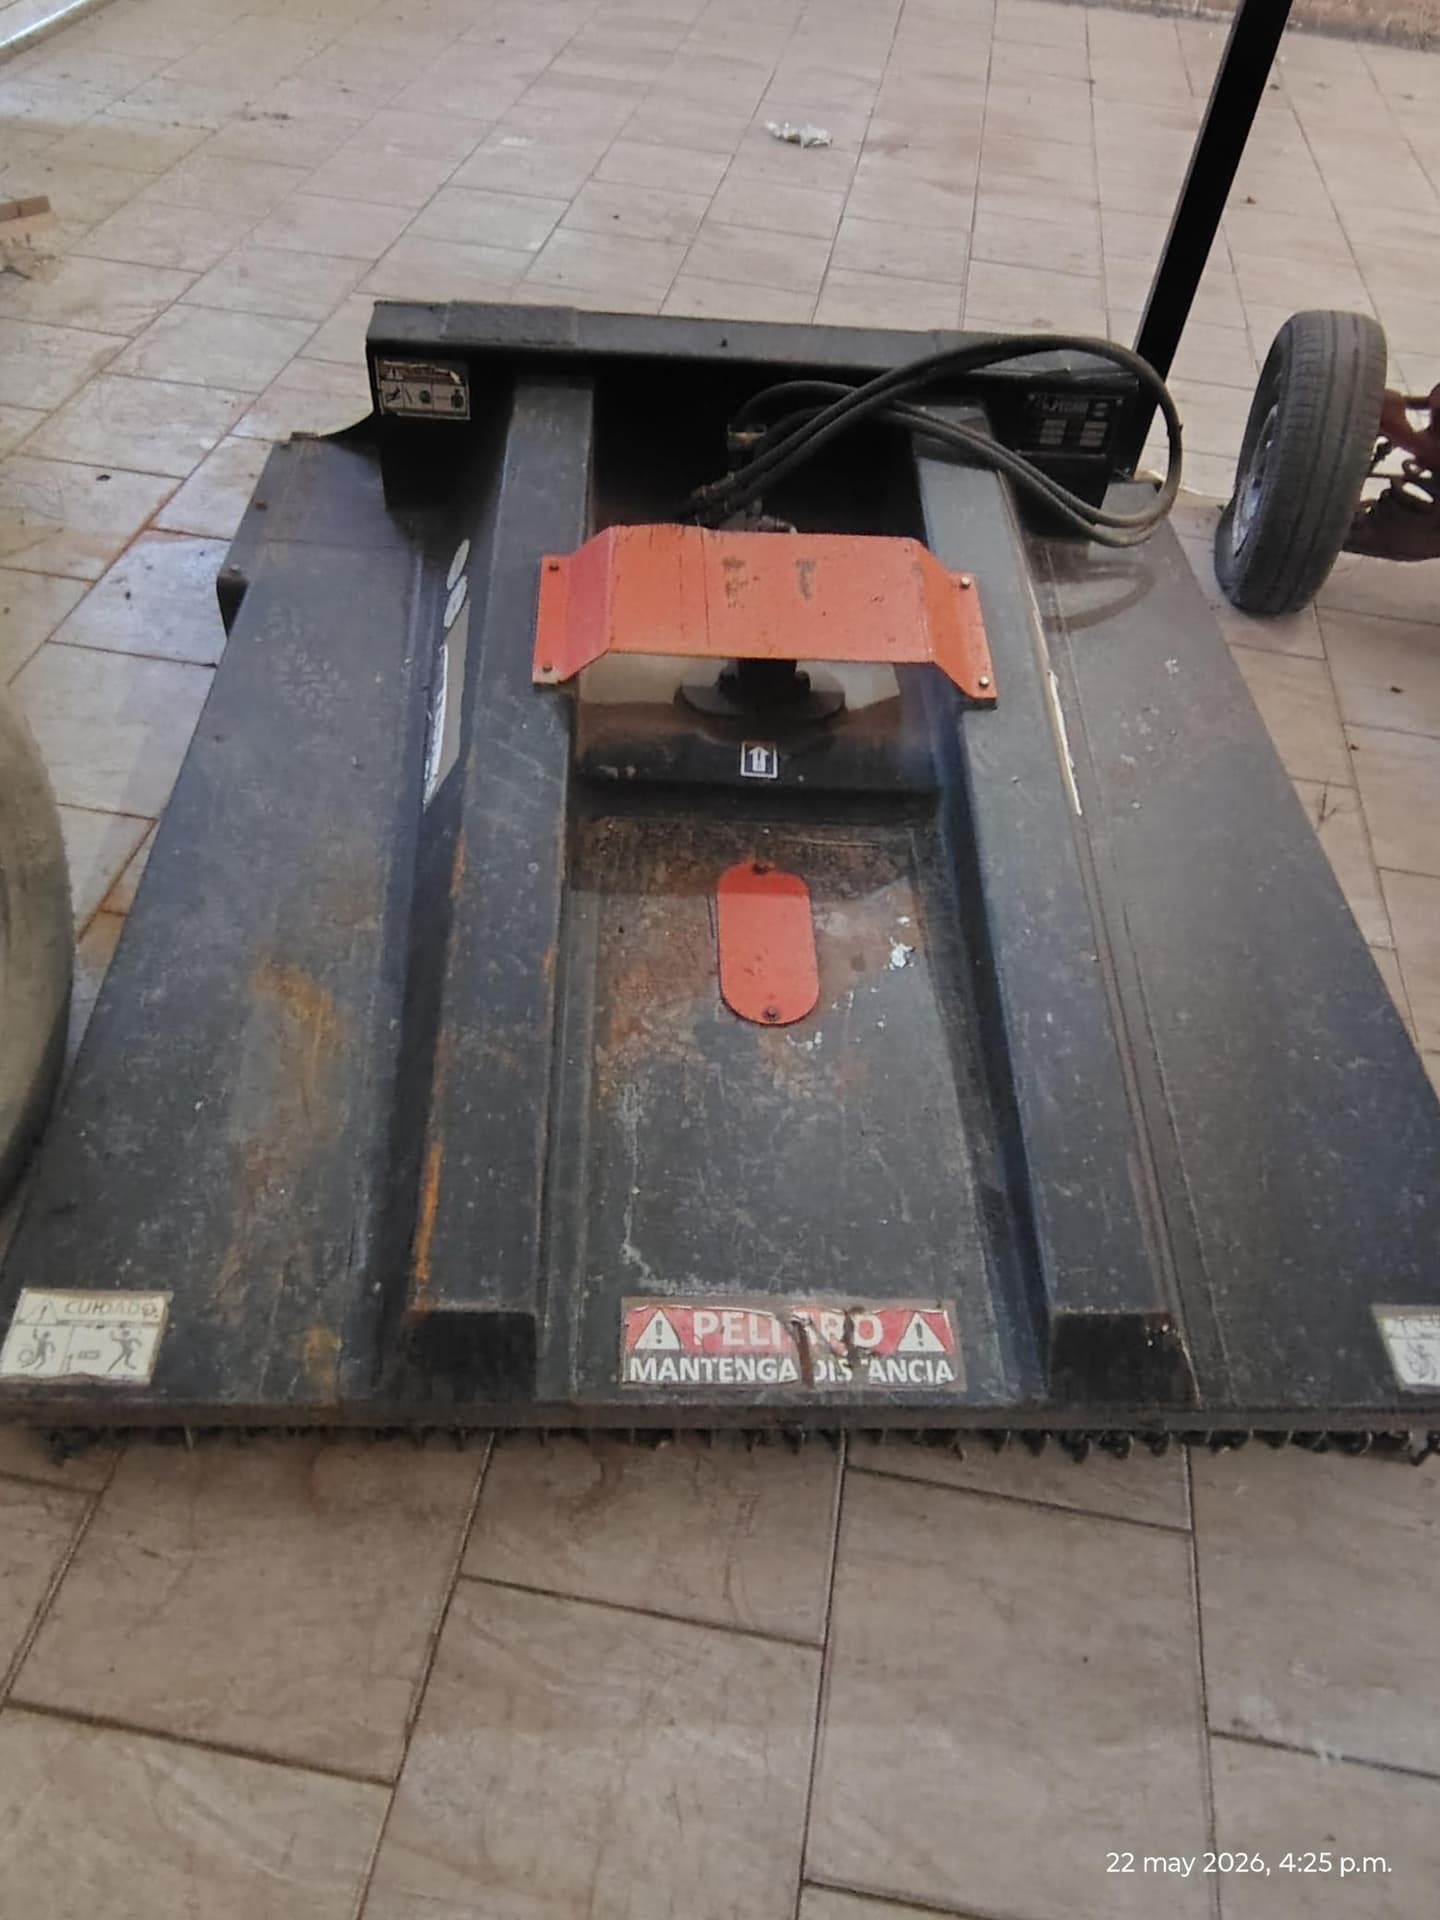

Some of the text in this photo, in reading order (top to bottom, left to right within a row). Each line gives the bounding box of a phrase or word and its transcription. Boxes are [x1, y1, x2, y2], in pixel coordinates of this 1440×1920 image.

[64, 1299, 158, 1316] CUIDADO
[693, 1311, 884, 1348] PELIRO
[629, 1356, 955, 1385] MANTENGA DISANCIA
